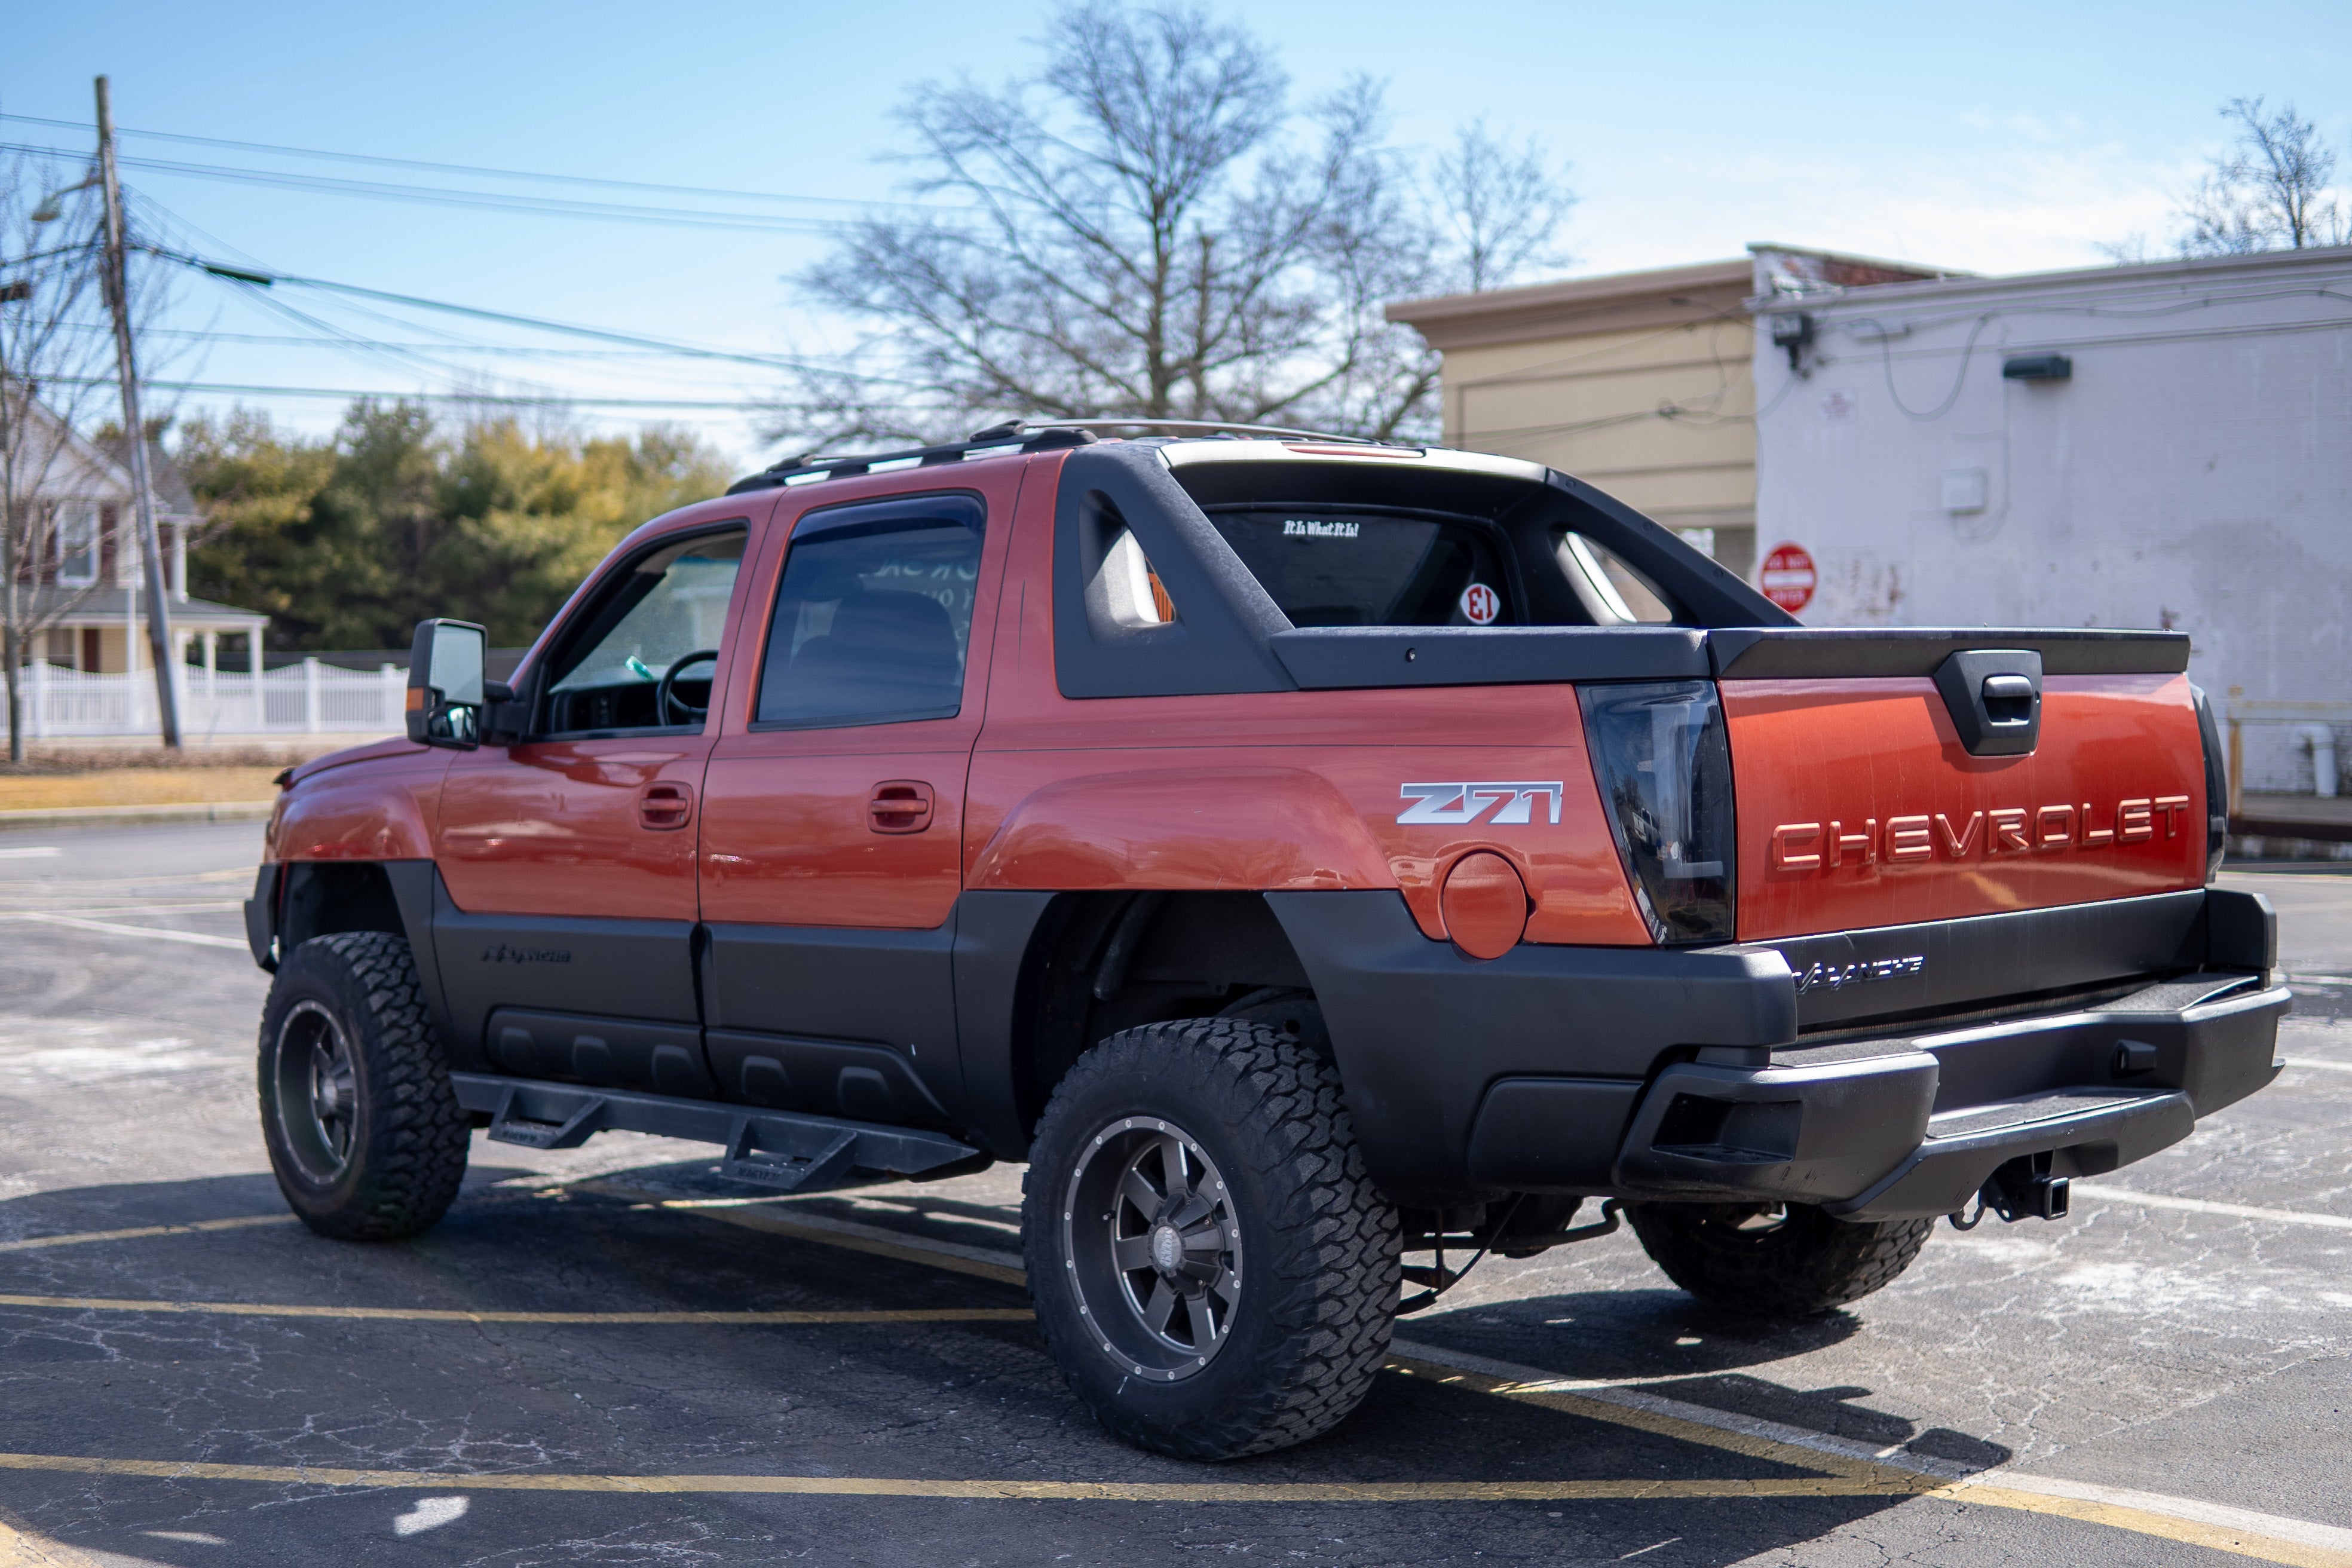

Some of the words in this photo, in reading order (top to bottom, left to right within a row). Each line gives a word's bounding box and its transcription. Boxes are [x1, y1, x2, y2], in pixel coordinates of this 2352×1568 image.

[1283, 520, 1296, 535] It
[1295, 520, 1306, 535] Is
[1307, 521, 1334, 537] What
[1333, 522, 1345, 537] It
[1345, 522, 1359, 537] Is!
[1768, 554, 1783, 569] DO
[1786, 553, 1808, 569] NOT
[1468, 585, 1493, 620] EI
[1770, 589, 1806, 604] ENTER
[1395, 780, 1564, 825] Z71
[1772, 795, 2189, 872] CHEVROLET
